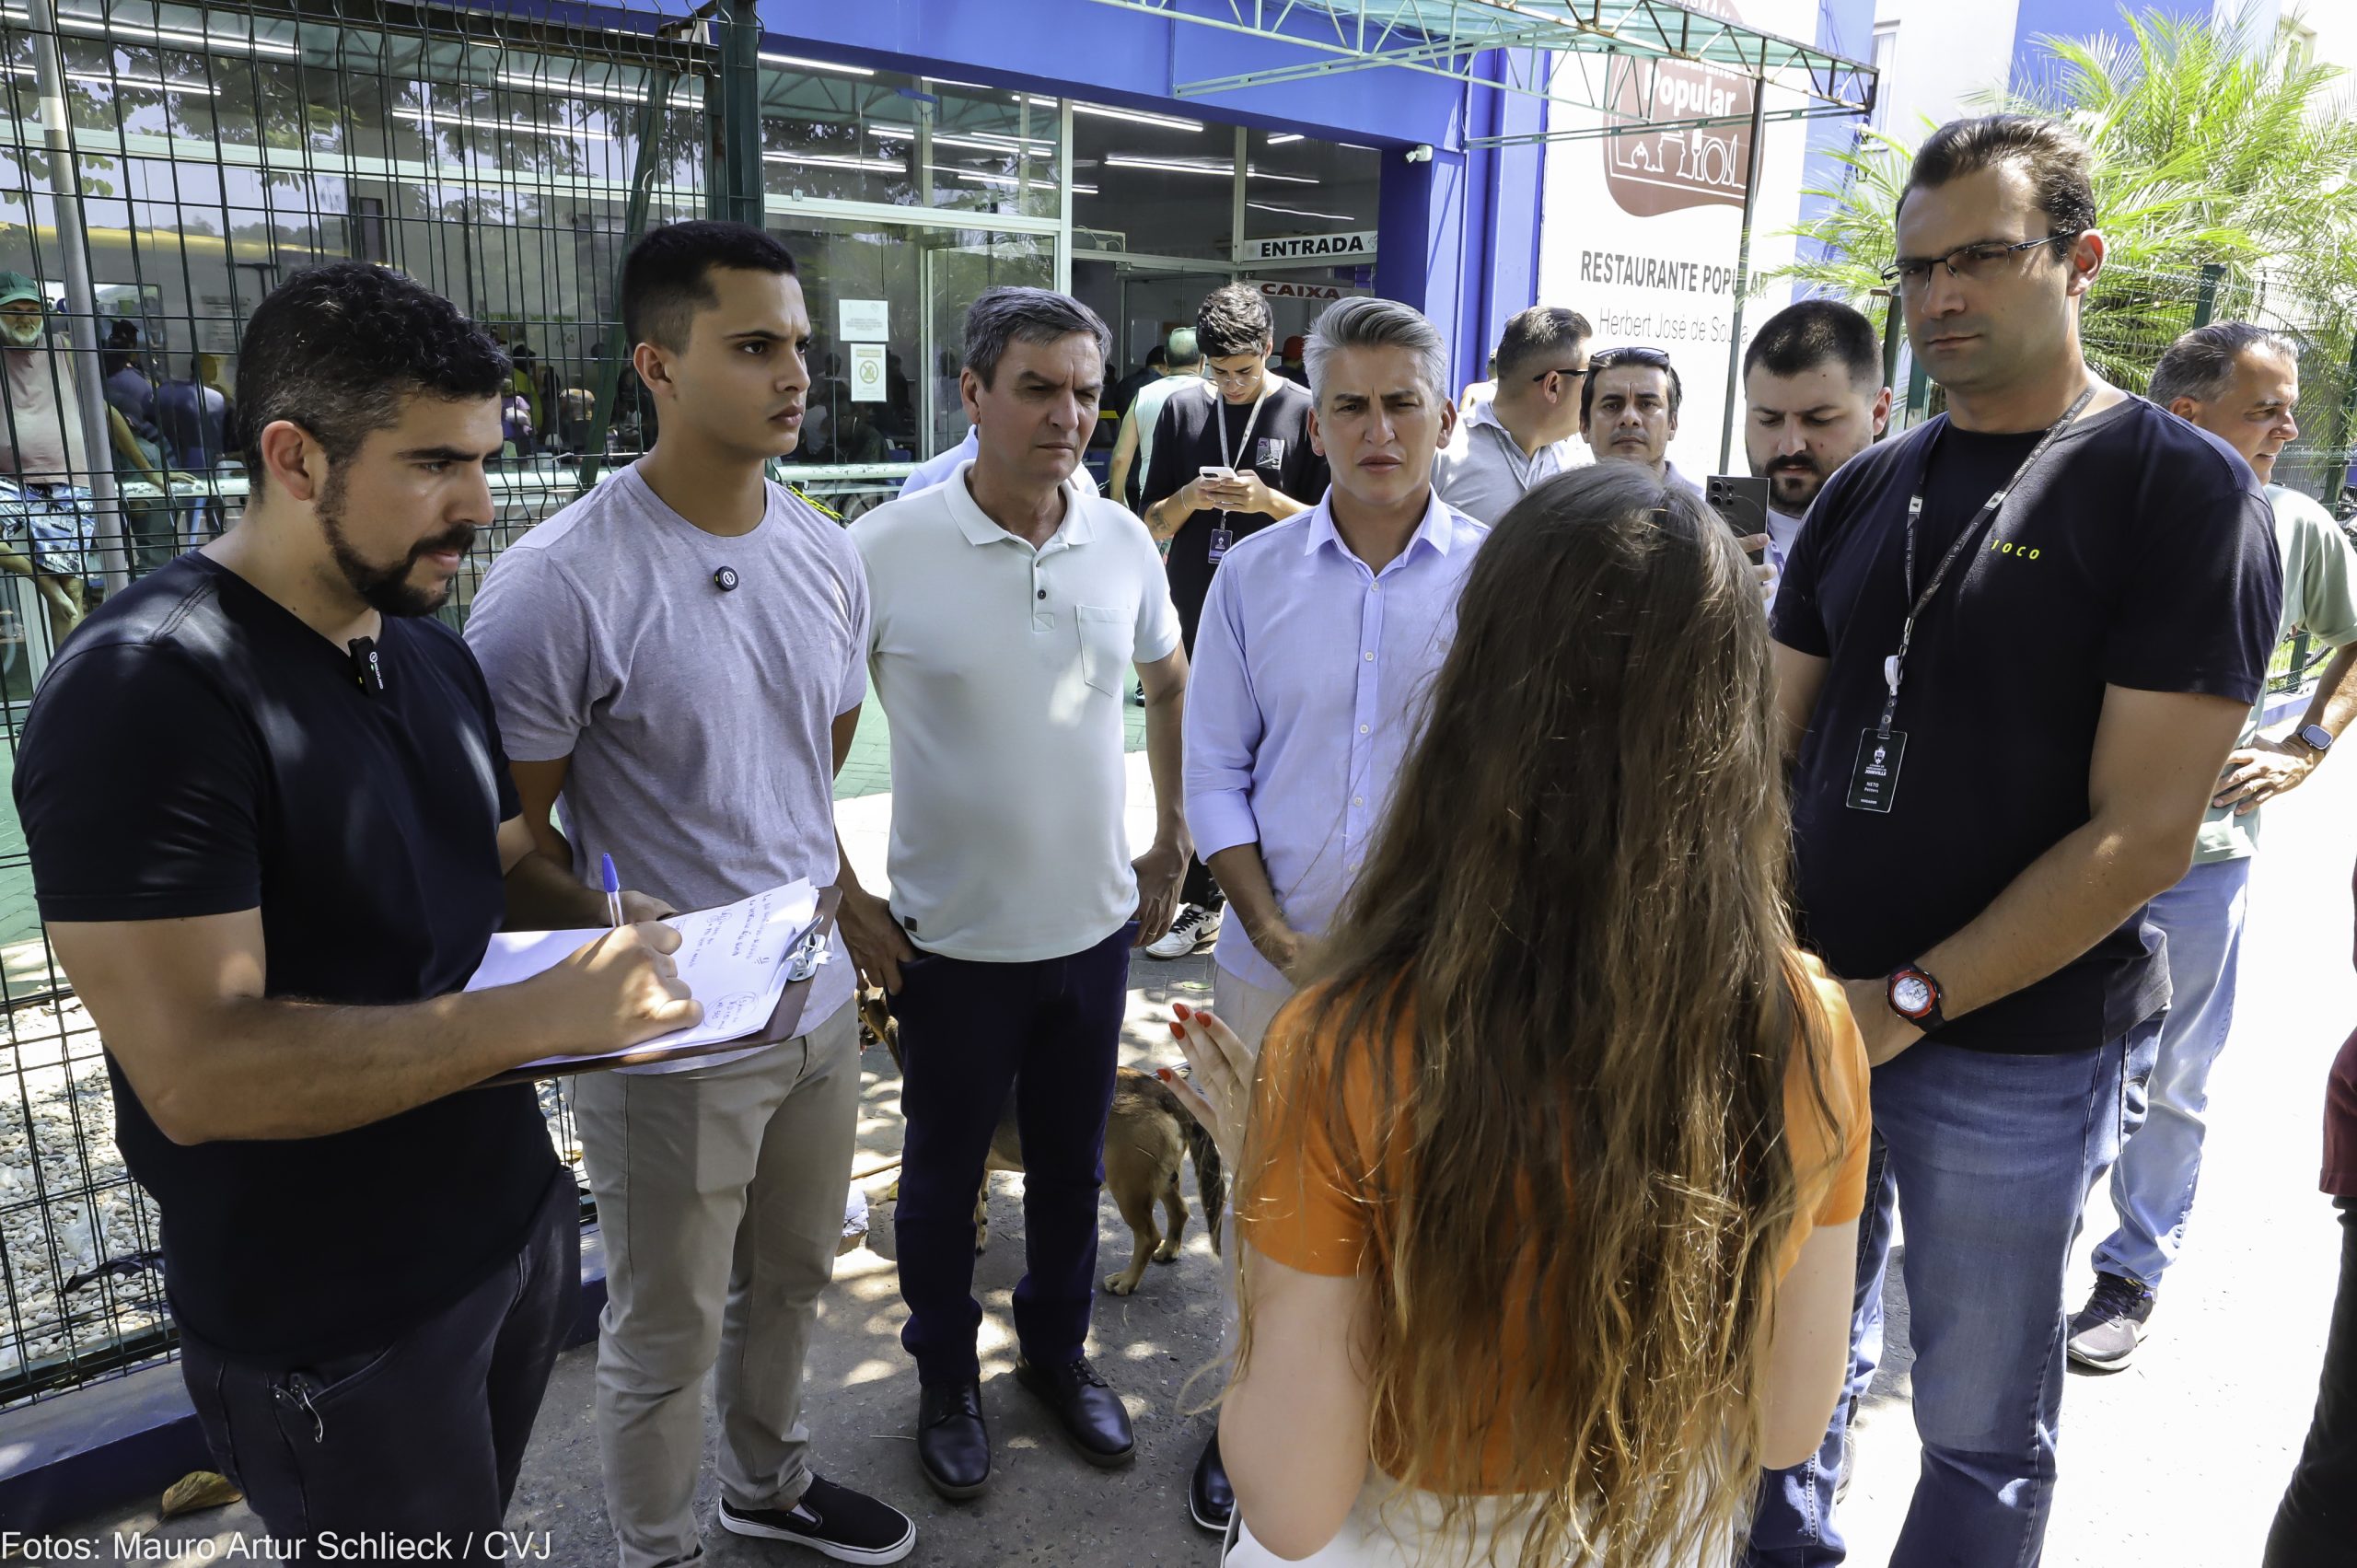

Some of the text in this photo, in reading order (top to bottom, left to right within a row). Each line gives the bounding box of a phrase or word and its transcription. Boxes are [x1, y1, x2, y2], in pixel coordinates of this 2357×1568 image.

[1643, 62, 1736, 117] Popular
[1261, 236, 1364, 257] ENTRADA
[1581, 250, 1698, 292] RESTAURANTE
[1260, 283, 1341, 299] CAIXA
[1599, 307, 1748, 343] Herbert José de Soua
[1991, 539, 2040, 560] JOCO
